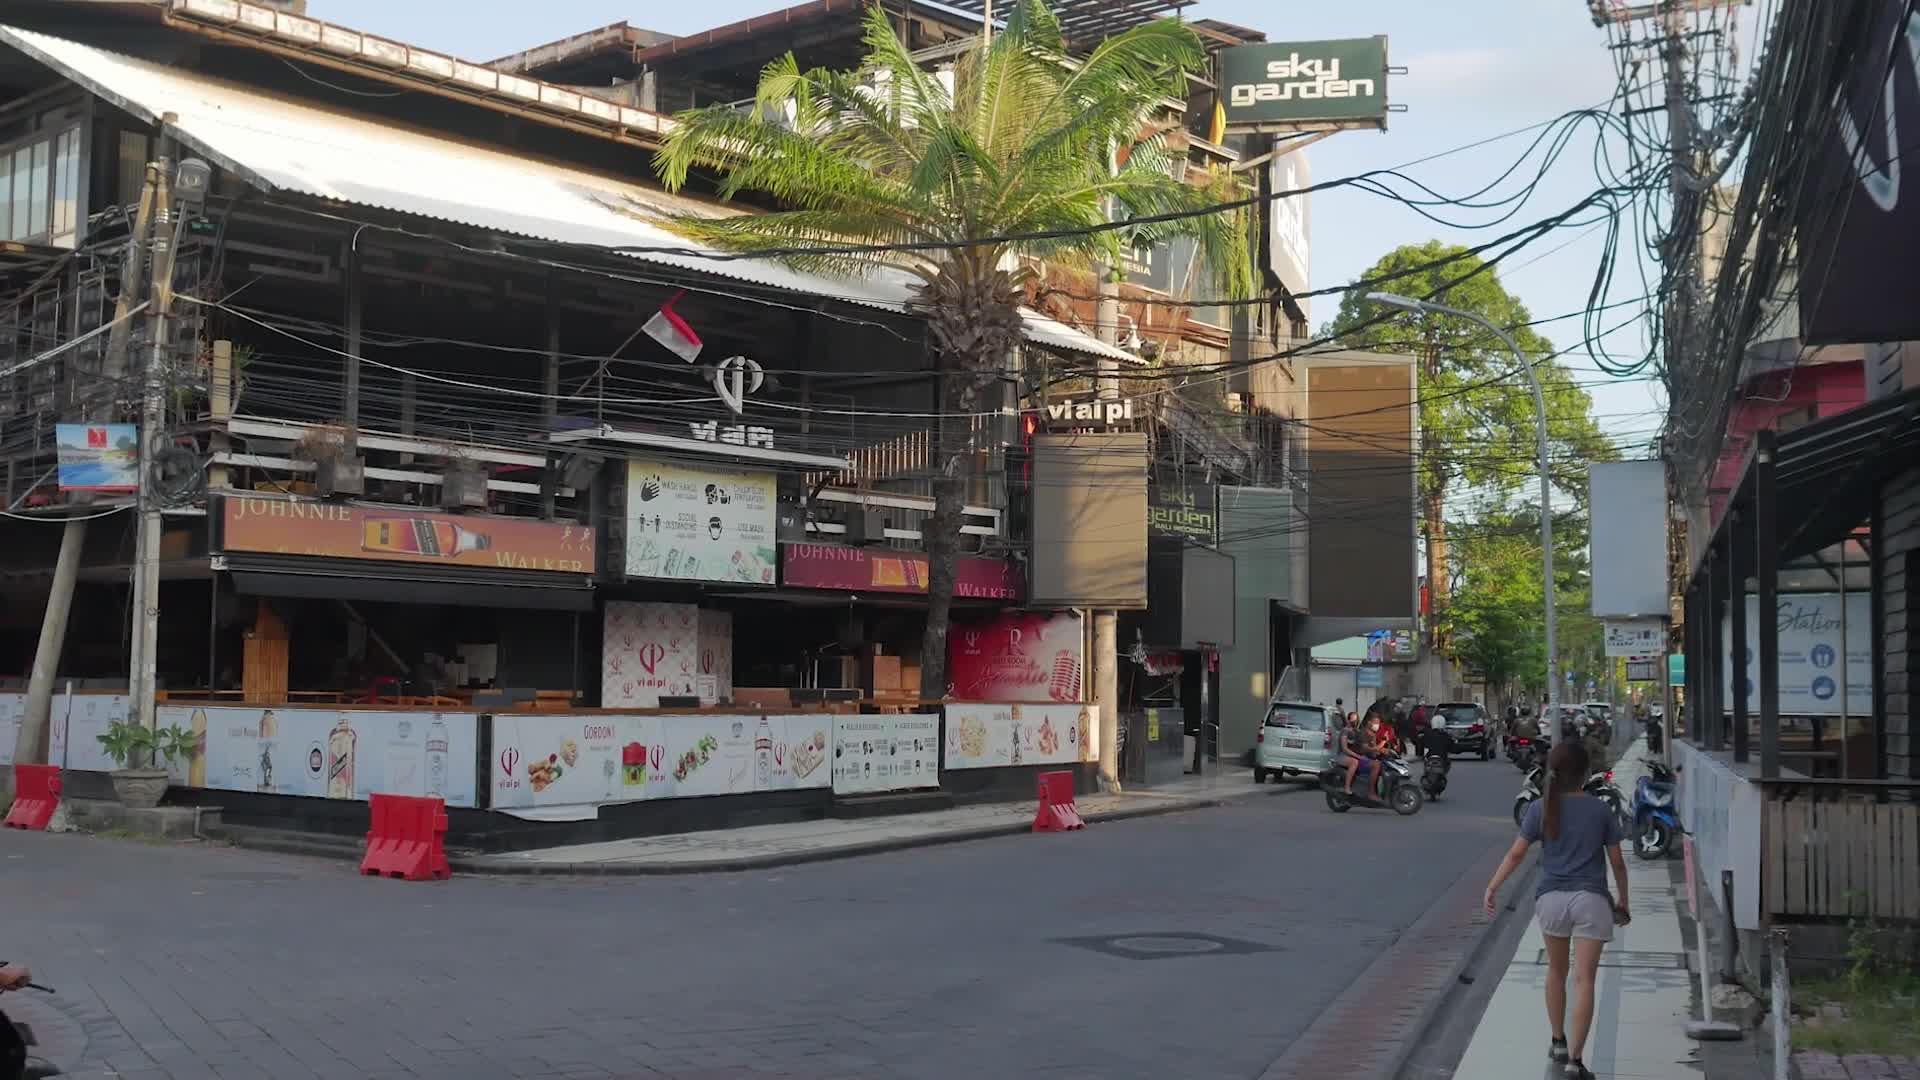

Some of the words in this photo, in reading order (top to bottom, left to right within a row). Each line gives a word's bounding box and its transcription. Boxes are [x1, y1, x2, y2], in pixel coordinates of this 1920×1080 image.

[1266, 52, 1340, 83] sky
[1230, 78, 1374, 107] garden
[234, 498, 353, 521] JOHNNIE
[788, 543, 865, 562] JOHNNIE
